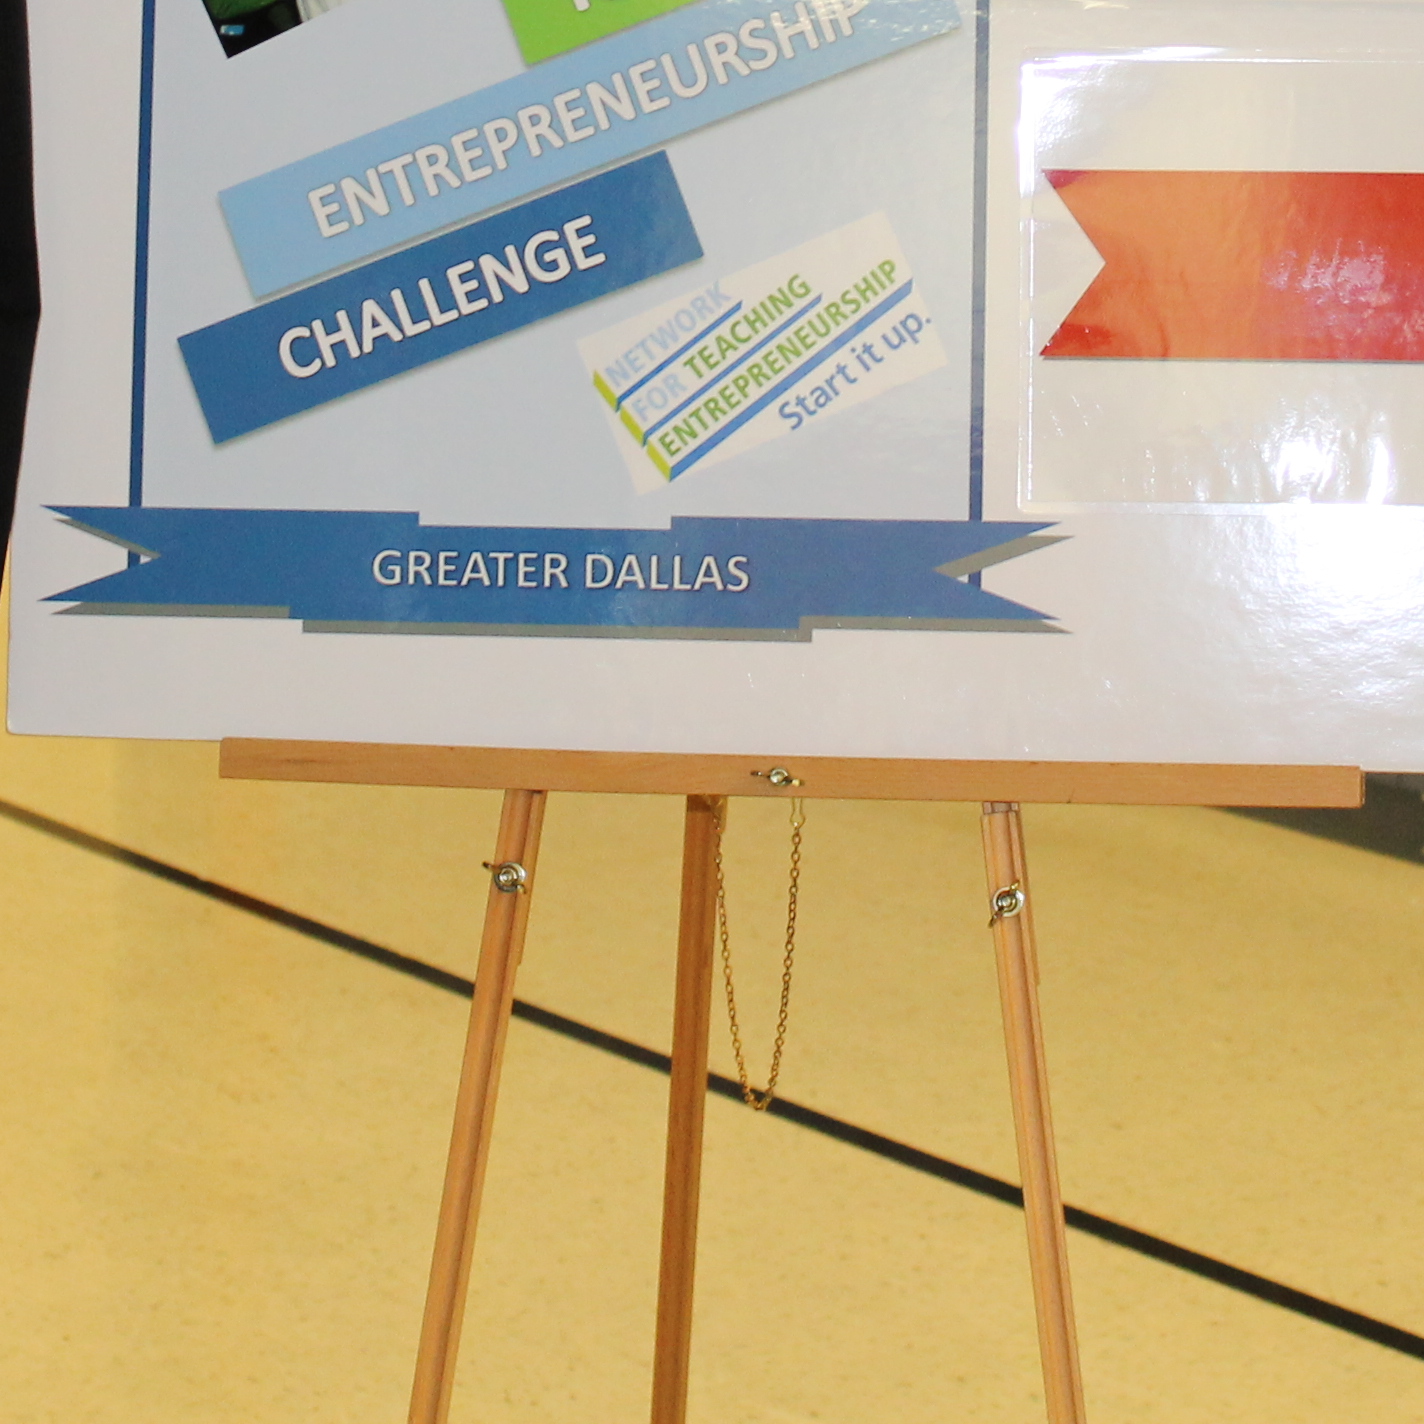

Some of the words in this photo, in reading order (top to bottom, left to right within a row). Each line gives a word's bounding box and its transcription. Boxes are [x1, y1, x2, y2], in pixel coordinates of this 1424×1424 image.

[277, 216, 607, 379] CHALLENGE
[605, 281, 732, 388] NETWORK
[631, 373, 688, 421] FOR
[683, 274, 812, 379] TEACHING
[659, 258, 898, 457] ENTREPRENEURSHIP
[778, 362, 858, 430] Start
[851, 341, 884, 373] it
[881, 311, 932, 353] up.
[373, 549, 568, 589] GREATER
[584, 552, 749, 593] DALLAS
